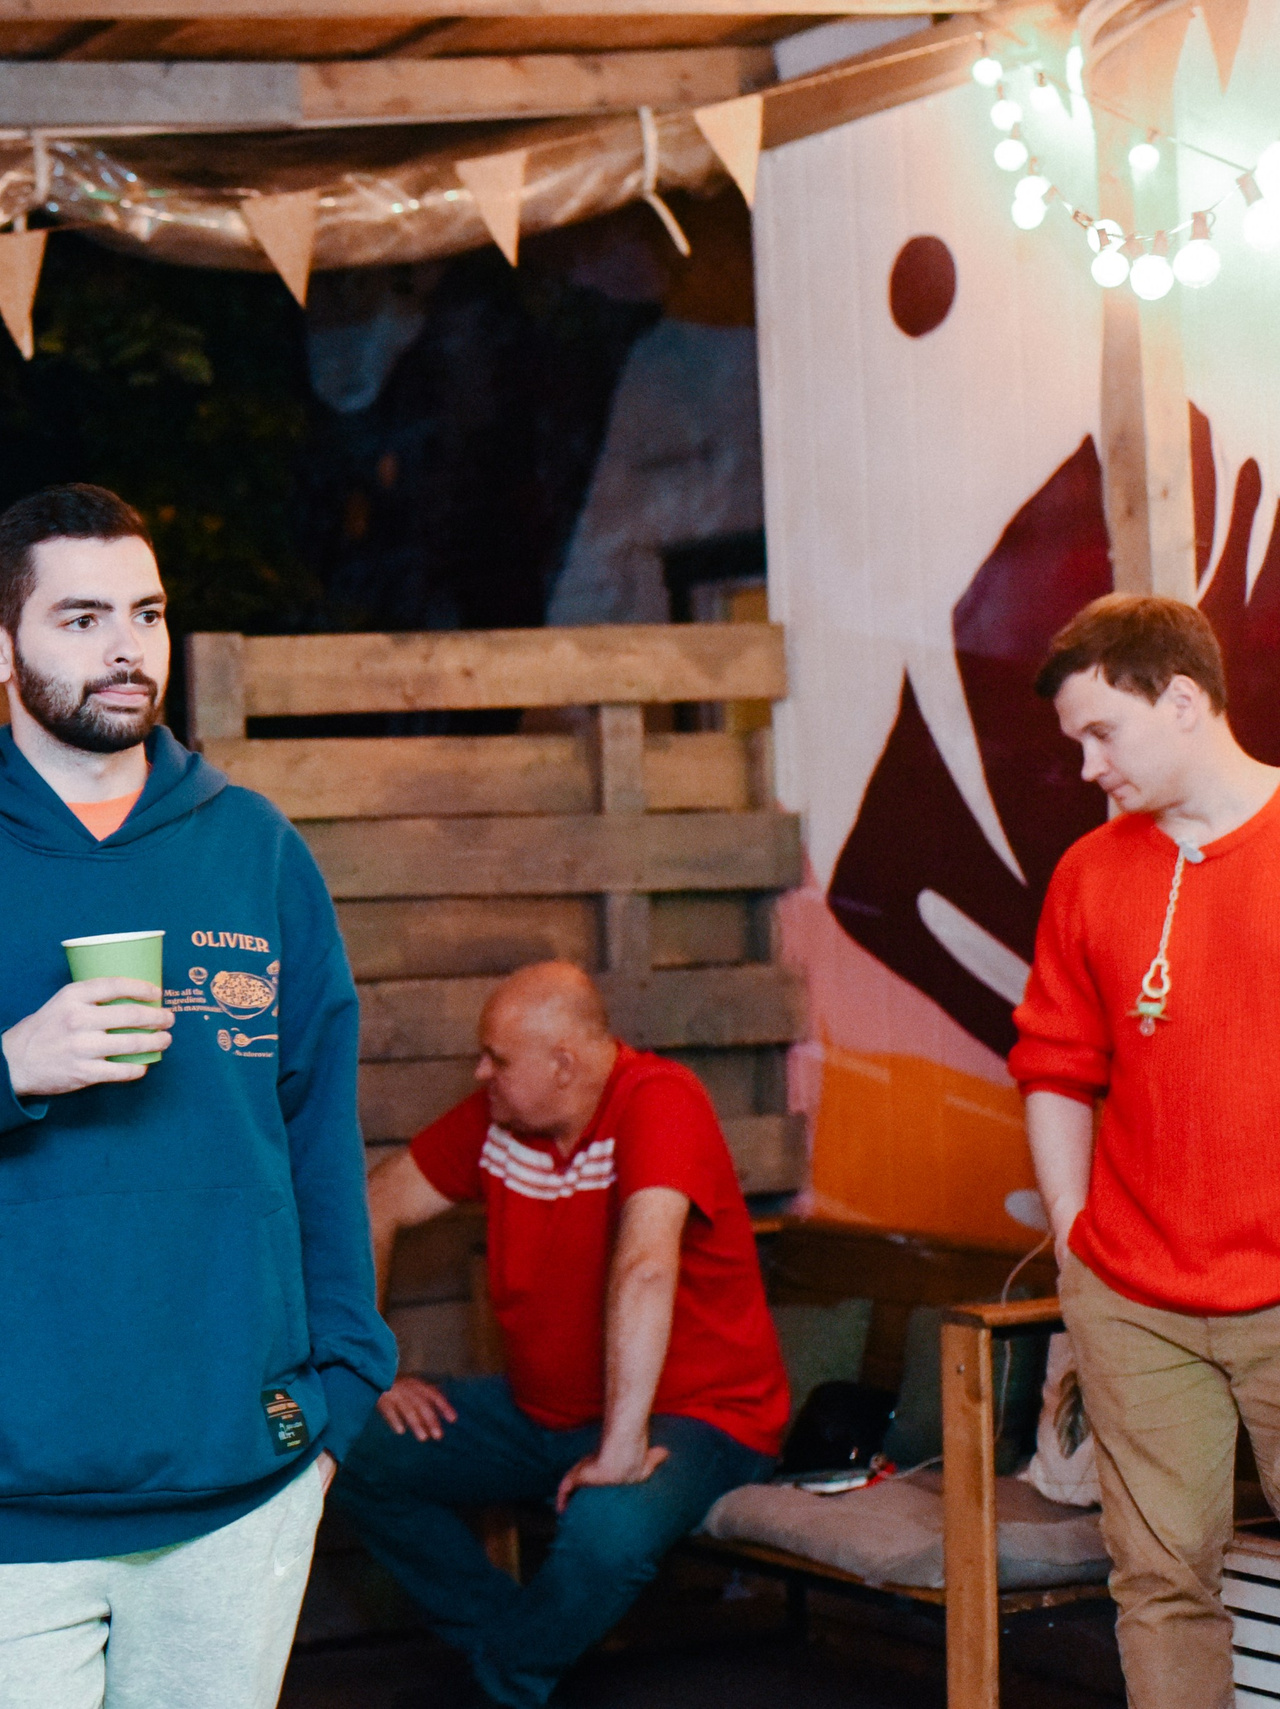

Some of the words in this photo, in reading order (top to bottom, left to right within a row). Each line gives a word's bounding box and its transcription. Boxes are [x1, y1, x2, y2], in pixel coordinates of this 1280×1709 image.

[191, 931, 270, 953] OLIVIER
[164, 989, 180, 997] Mix
[181, 988, 191, 997] all
